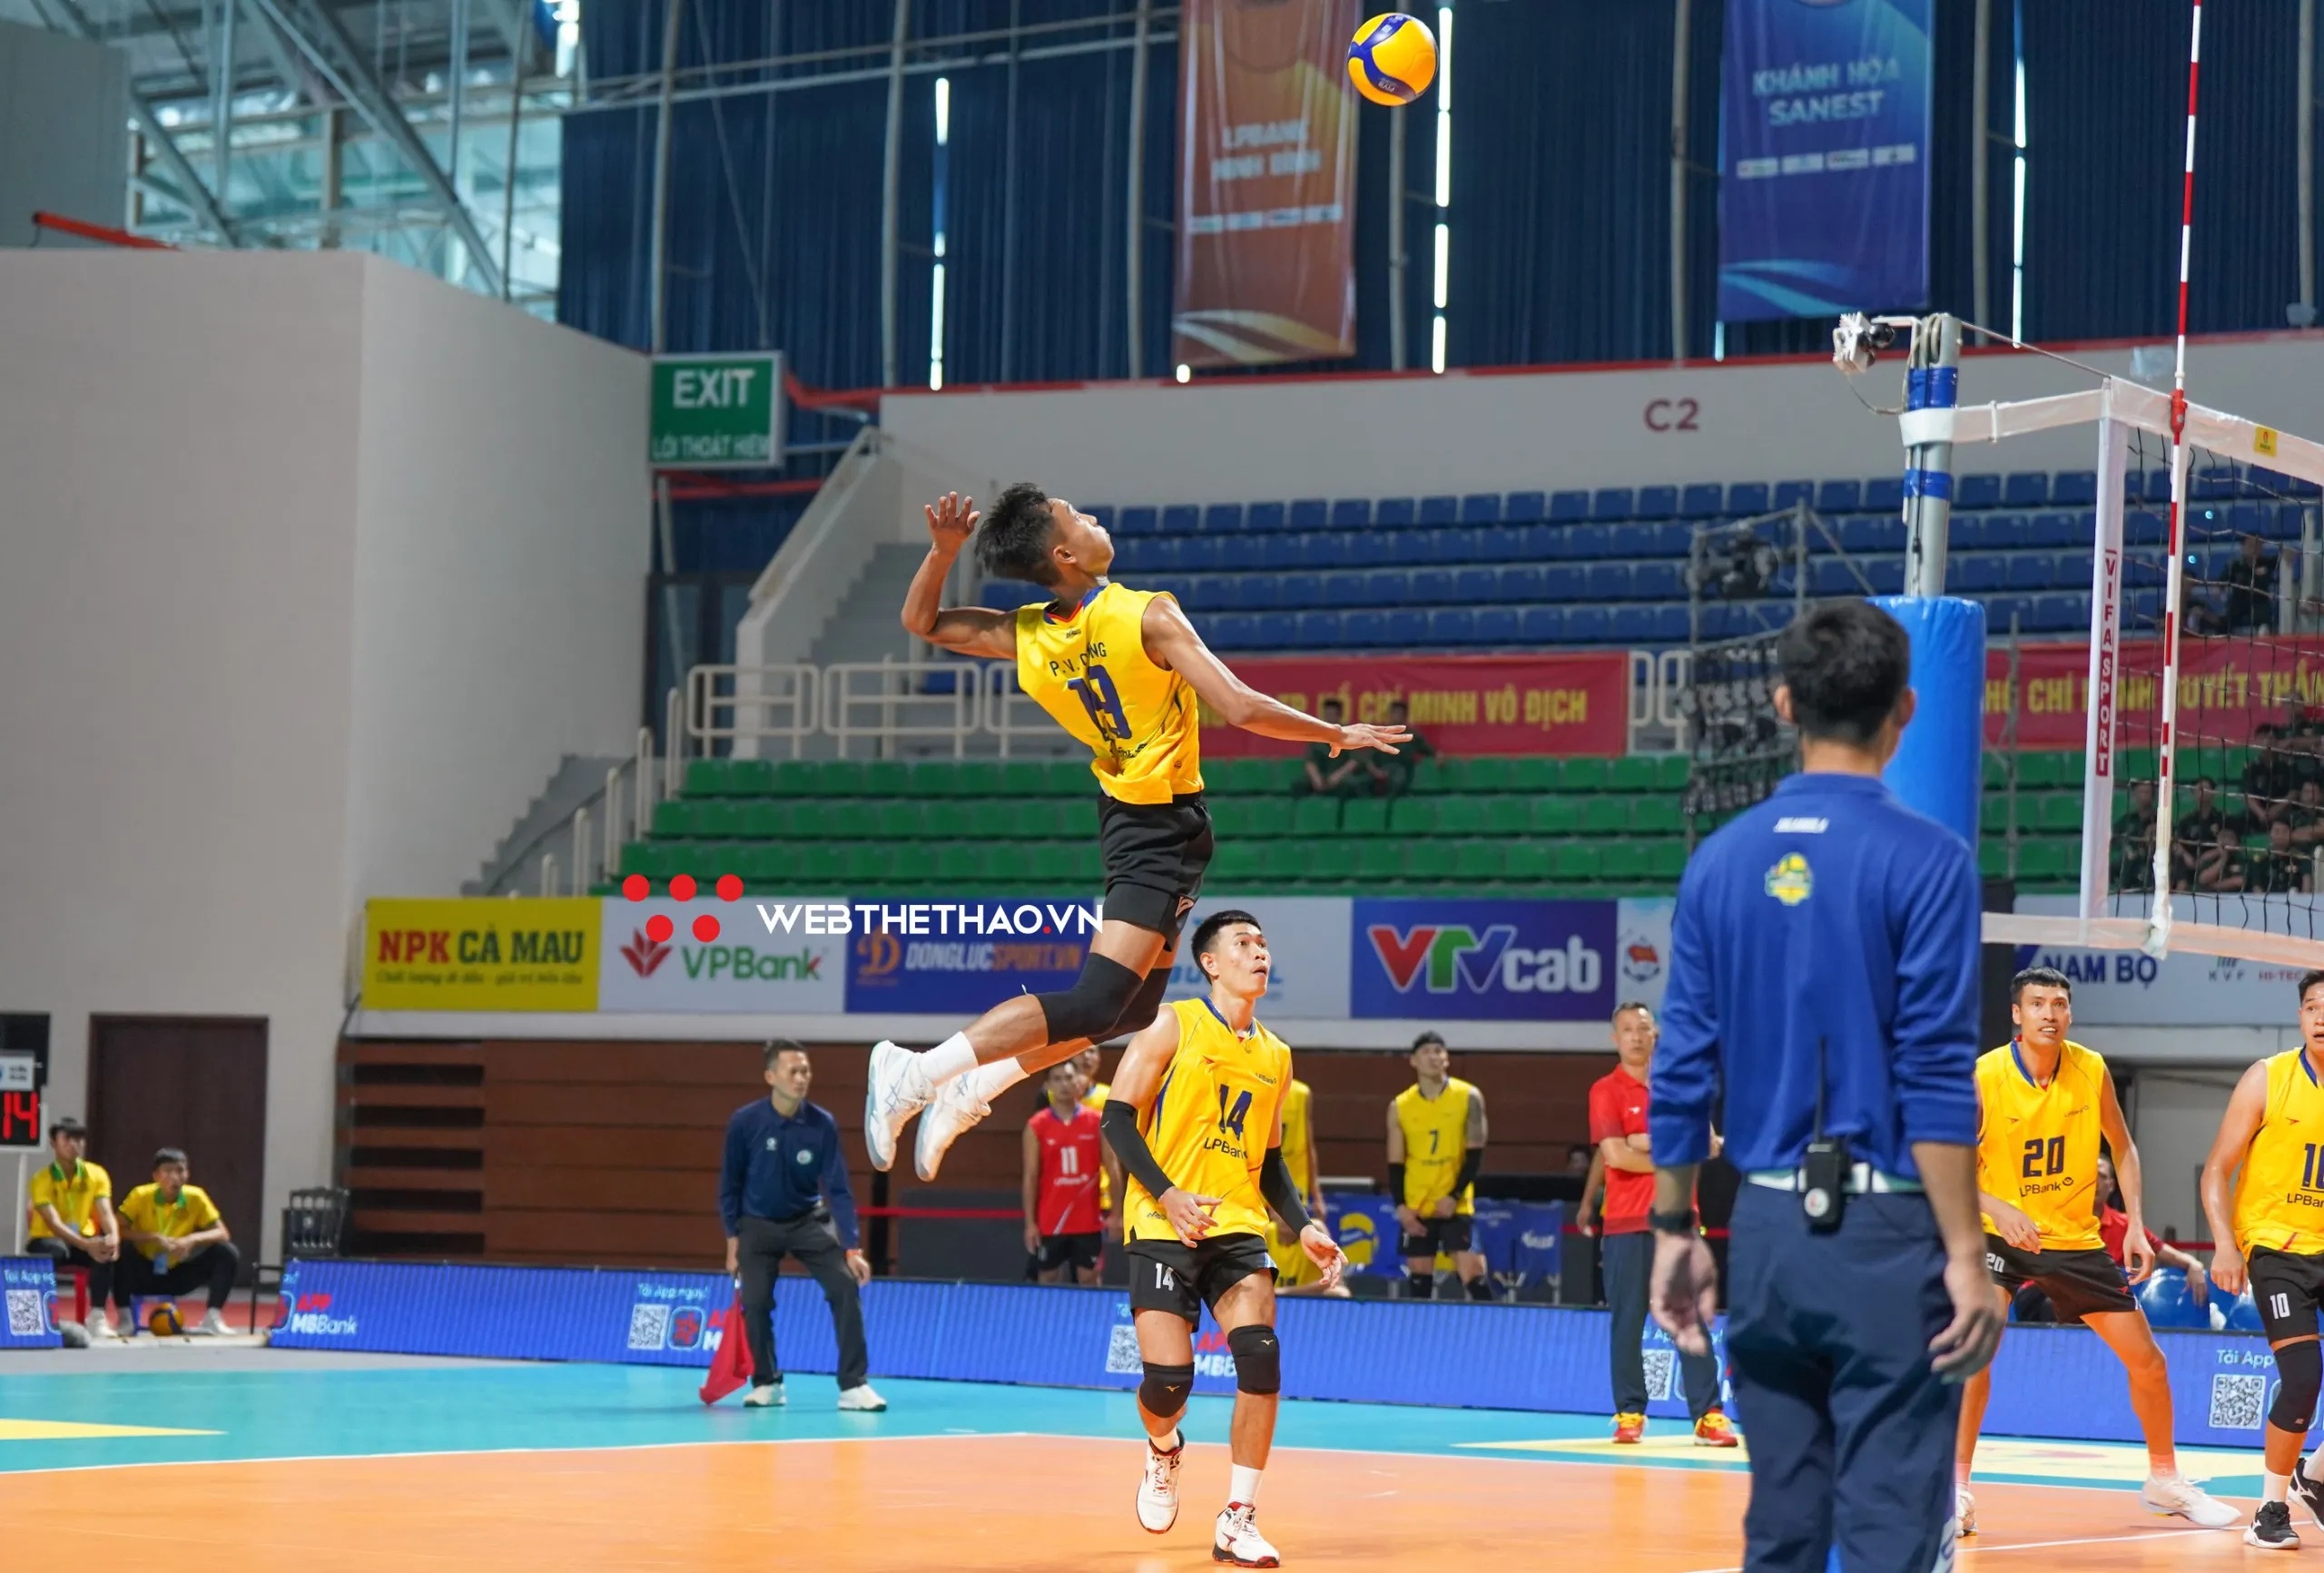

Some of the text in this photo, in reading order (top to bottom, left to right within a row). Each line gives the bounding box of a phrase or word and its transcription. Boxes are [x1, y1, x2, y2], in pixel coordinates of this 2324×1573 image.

[1769, 90, 1886, 126] SANEST
[673, 369, 756, 408] EXIT
[1643, 398, 1699, 432] C2
[378, 930, 451, 964] NPK
[509, 930, 585, 964] MAU
[682, 945, 824, 981] VPBank
[3, 1092, 39, 1140] 14
[1218, 1083, 1253, 1142] 14
[1428, 1128, 1439, 1155] 7
[2023, 1135, 2065, 1178] 20
[1060, 1146, 1078, 1175] 11
[2018, 1181, 2062, 1198] LPBank
[1155, 1263, 1175, 1292] 14
[1985, 1252, 2005, 1273] 20
[2270, 1292, 2290, 1320] 10
[2216, 1349, 2275, 1370] Tải App
